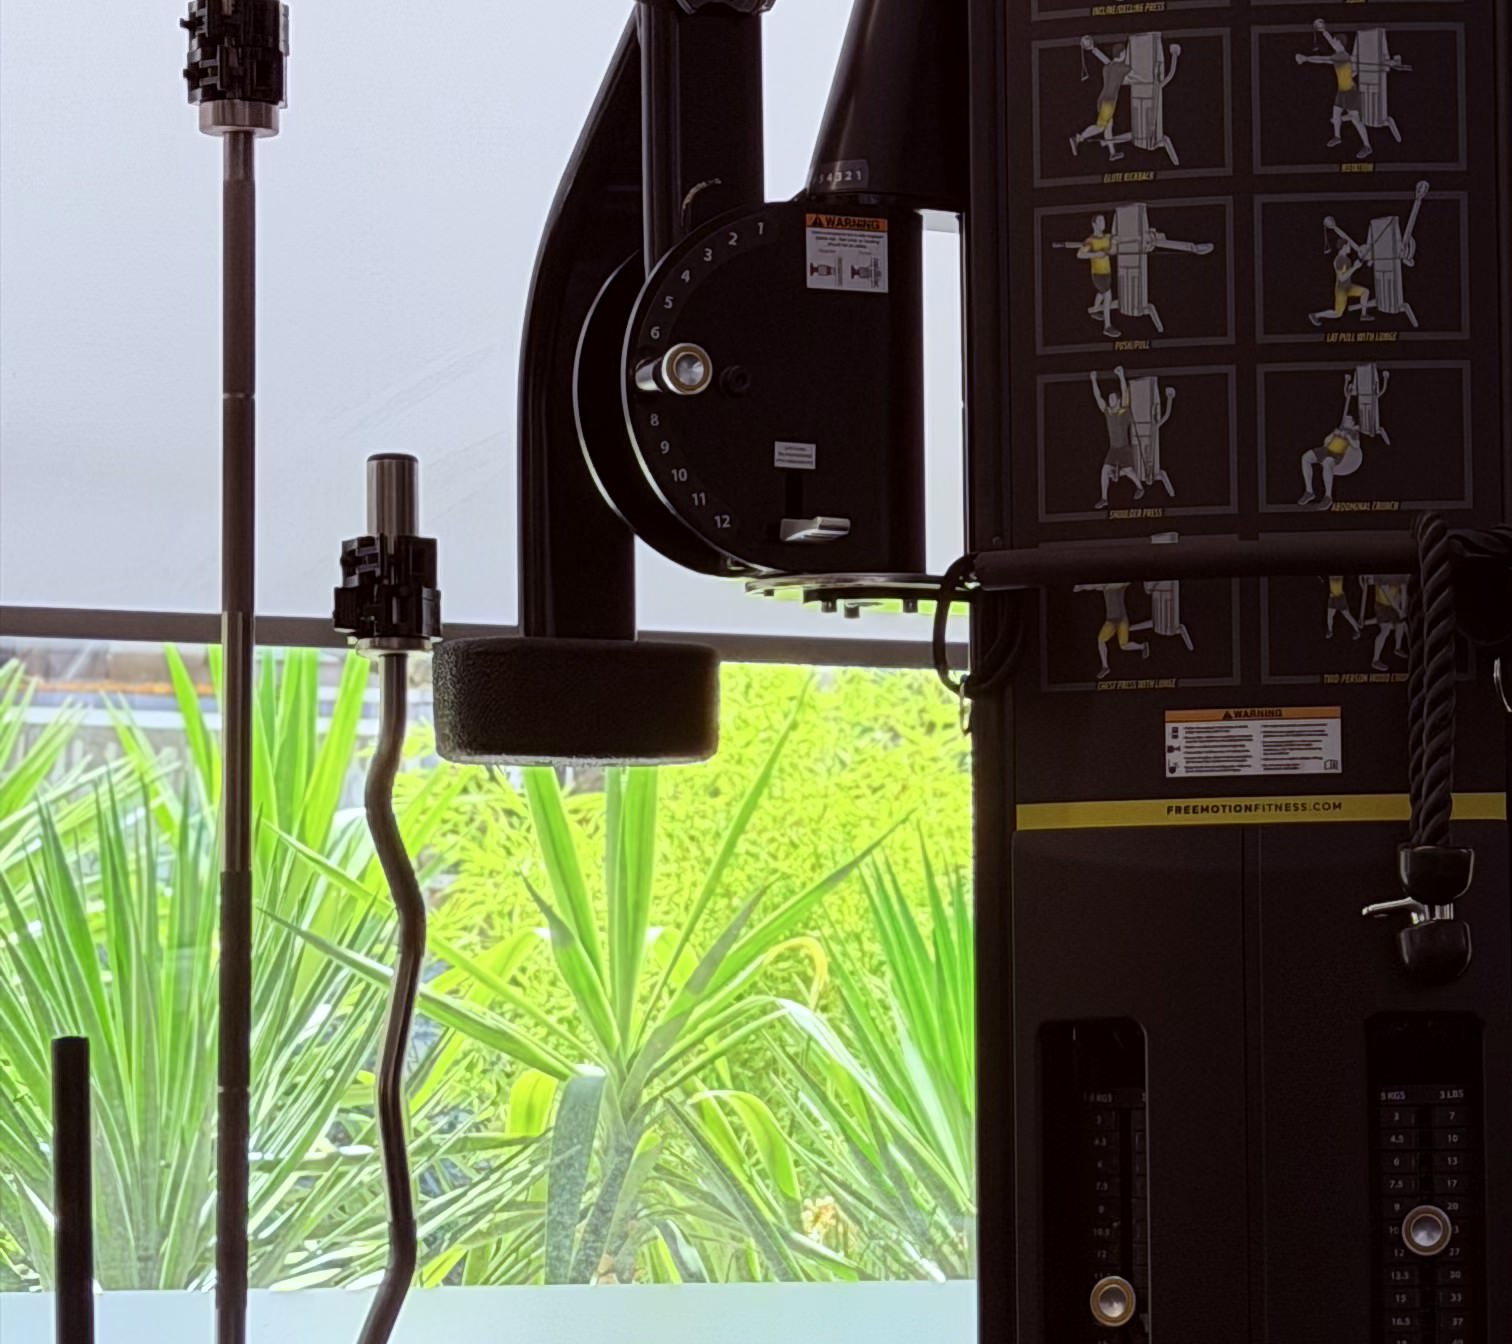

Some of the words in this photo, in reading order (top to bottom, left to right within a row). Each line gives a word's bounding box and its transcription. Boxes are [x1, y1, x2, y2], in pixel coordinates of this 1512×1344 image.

[844, 170, 852, 181] 2
[856, 170, 861, 180] 1
[758, 222, 764, 234] 1
[824, 216, 880, 230] WARNING
[728, 232, 738, 246] 2
[704, 248, 712, 262] 3
[680, 270, 690, 282] 4
[664, 296, 674, 308] 5
[650, 326, 660, 340] 6
[650, 414, 660, 426] 8
[660, 440, 670, 454] 9
[672, 468, 688, 482] 10
[692, 492, 706, 506] 11
[714, 514, 730, 528] 12
[1234, 709, 1283, 718] WARNING
[1167, 802, 1342, 815] FREEMOTIONFITNESS.COM
[1448, 1180, 1458, 1188] 17
